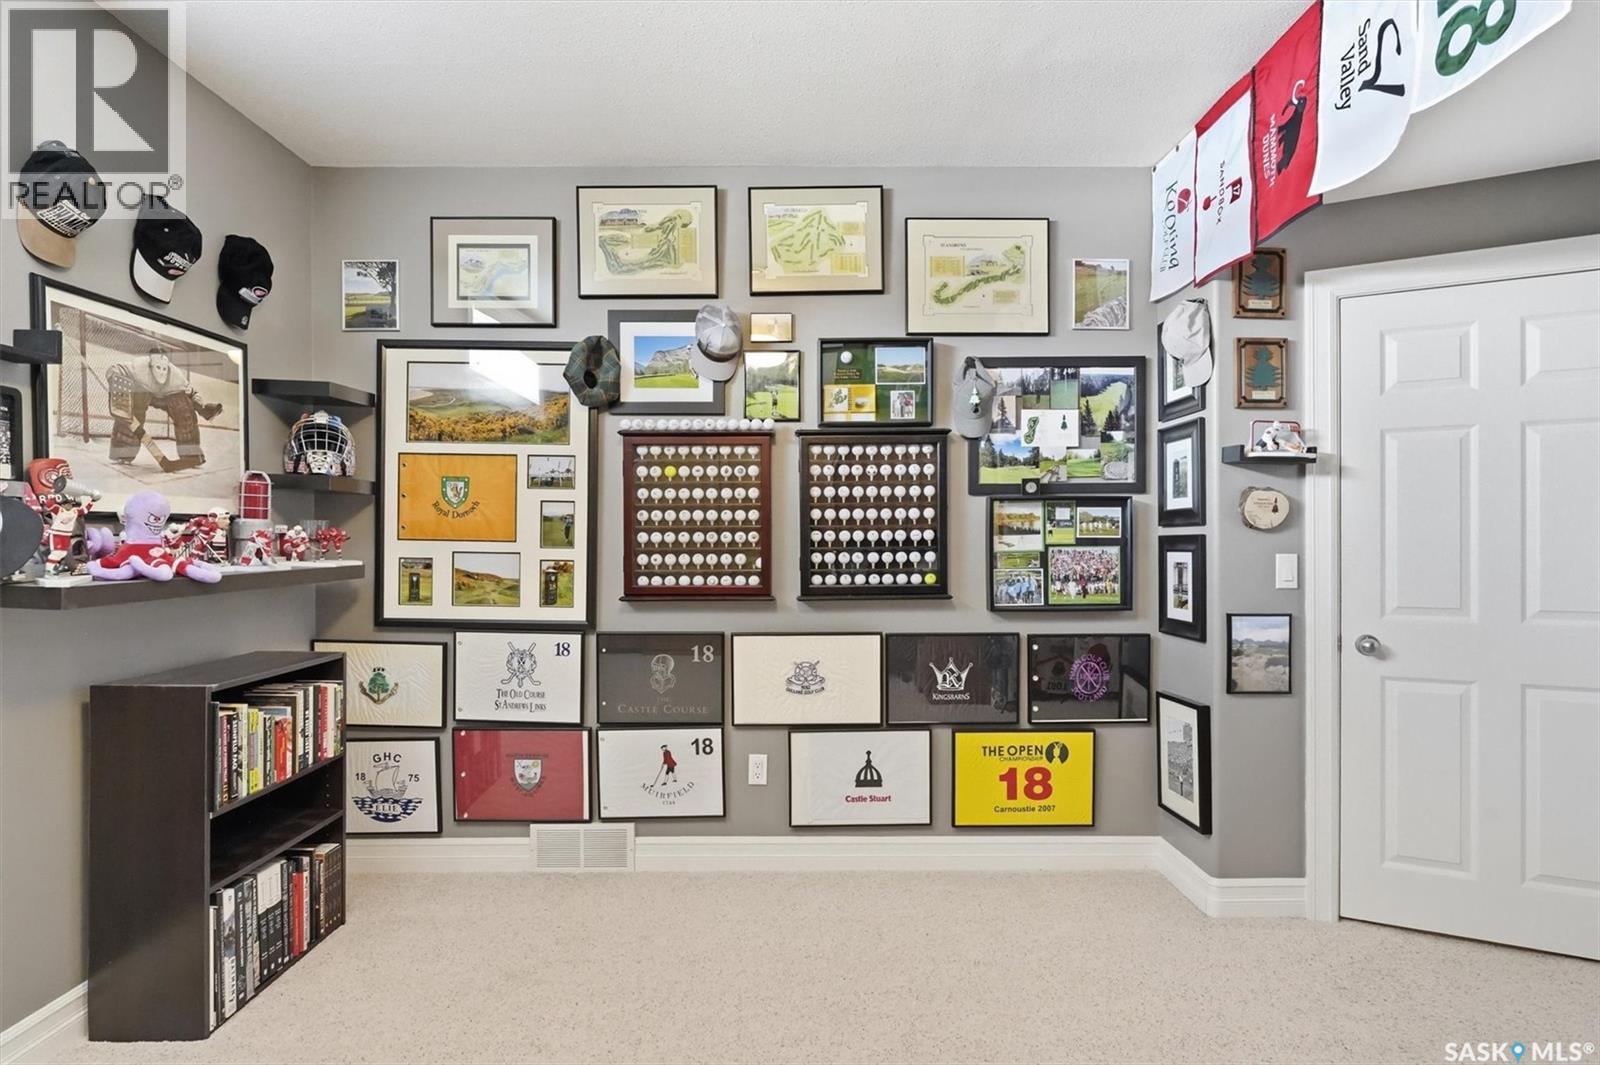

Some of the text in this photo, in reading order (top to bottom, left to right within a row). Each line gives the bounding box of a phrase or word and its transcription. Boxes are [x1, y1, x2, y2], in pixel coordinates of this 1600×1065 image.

[1357, 18, 1371, 76] Sand
[1334, 44, 1356, 111] Valley
[1262, 133, 1271, 180] DUNES
[1268, 113, 1278, 188] MAMMOTH
[1215, 160, 1227, 227] SANDBOX
[1232, 183, 1241, 197] 17
[432, 500, 481, 519] Royal Dornoch
[554, 641, 571, 657] 18
[690, 644, 714, 663] 18
[496, 688, 546, 699] THE OLD COURSE
[932, 692, 971, 701] KINGSBARNS
[1071, 685, 1108, 702] SCOTLAND
[501, 699, 529, 710] ANDREWS
[529, 702, 547, 713] LINKS
[617, 703, 709, 714] CASTLE COURSE
[690, 737, 714, 756] 18
[982, 745, 1044, 757] THE OPEN
[372, 752, 402, 764] GHC
[355, 772, 420, 783] 18 75
[998, 766, 1053, 801] 18
[640, 781, 695, 799] MUIRFIELD
[845, 795, 868, 803] Castle
[375, 804, 399, 812] ELIE
[994, 805, 1036, 813] Carnoustie
